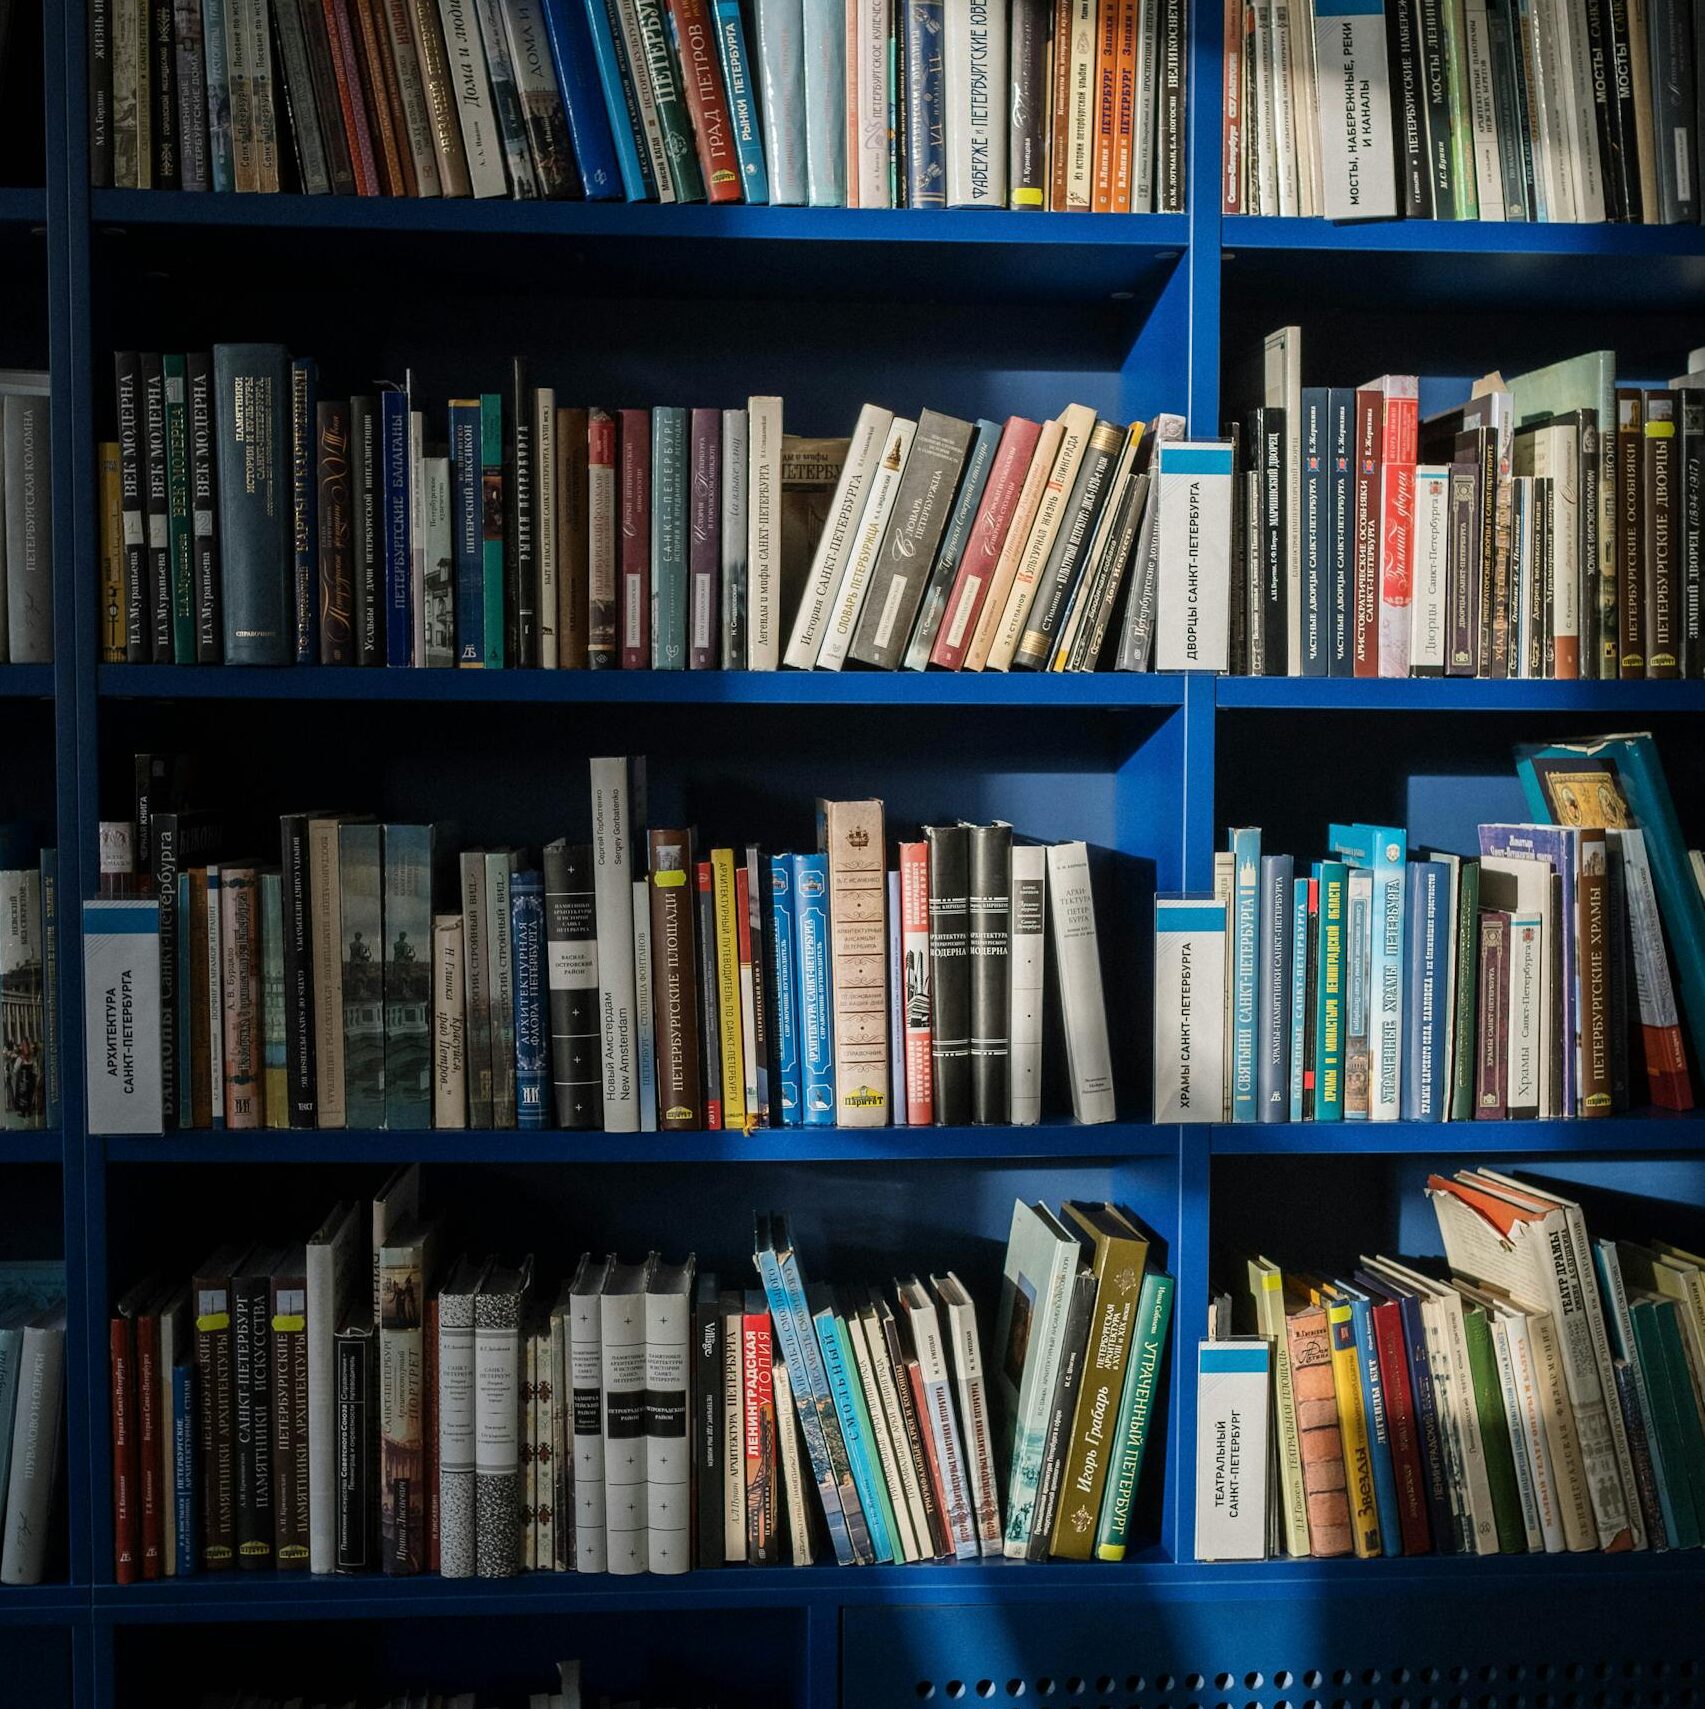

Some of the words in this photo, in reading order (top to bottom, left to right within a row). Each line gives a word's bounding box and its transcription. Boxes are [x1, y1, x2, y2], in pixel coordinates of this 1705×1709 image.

[517, 7, 528, 20] И
[1342, 22, 1353, 56] РЕКИ
[461, 48, 469, 57] и
[523, 25, 544, 77] ДОМА
[688, 24, 716, 101] ПЕТРОВ
[724, 22, 745, 94] ПЕТЕРБУРГА
[970, 30, 988, 126] ПЕТЕРБУРГСКИЕ
[1429, 54, 1443, 104] МОСТЫ
[1592, 47, 1607, 103] МОСТЫ
[1616, 43, 1631, 98] МОСТЫ
[181, 80, 192, 155] ЗНАМЕНИТЫЕ
[463, 64, 481, 108] Дома
[1343, 60, 1358, 153] НАБЕРЕЖНЫЕ,
[1360, 80, 1372, 134] КАНАЛЫ
[704, 108, 726, 157] ГРАД
[733, 99, 752, 141] РЫНКИ
[1362, 138, 1372, 147] И
[971, 137, 988, 198] ФАБЕРЖЕ
[1348, 156, 1360, 205] МОСТЫ,
[120, 373, 135, 456] МОДЕРНА
[147, 375, 163, 458] МОДЕРНА
[193, 373, 208, 457] МОДЕРНА
[234, 377, 244, 441] ПАМЯТНИКИ
[244, 377, 254, 432] КУЛЬТУРЫ
[23, 410, 35, 471] КОЛОМНА
[246, 434, 254, 444] И
[246, 445, 255, 493] ИСТОРИИ
[391, 414, 404, 488] БАЛАГАНЫ
[463, 424, 474, 486] ЛЕКСИКОН
[1045, 435, 1079, 493] ЛЕНИНГРАДА
[1267, 432, 1280, 468] ДВОРЕЦ
[123, 461, 138, 496] ВЕК
[151, 463, 165, 499] ВЕК
[196, 461, 210, 497] ВЕК
[663, 418, 674, 562] САНКТ-ПЕТЕРБУРГ
[915, 470, 943, 540] ПЕТЕРБУРЖЦА
[1266, 469, 1280, 527] МАРИИНСКИЙ
[1586, 469, 1596, 543] МИХАЙЛОВСКИЙ
[1626, 443, 1638, 523] ОСОБНЯКИ
[1656, 439, 1670, 508] ДВОРЦЫ
[24, 473, 36, 572] ПЕТЕРБУРГСКАЯ
[464, 488, 476, 553] ПИТЕРСКИЙ
[758, 464, 770, 560] САНКТ-ПЕТЕРБУРГА
[1039, 495, 1059, 526] ЖИЗНЬ
[1187, 482, 1200, 603] САНКТ-ПЕТЕРБУРГА
[1308, 478, 1318, 568] САНКТ-ПЕТЕРБУРГА
[1336, 478, 1346, 568] САНКТ-ПЕТЕРБУРГА
[1359, 480, 1368, 541] ОСОБНЯКИ
[392, 496, 406, 609] ПЕТЕРБУРГСКИЕ
[758, 563, 771, 594] мифы
[800, 599, 823, 646] История
[815, 474, 863, 596] САНКТ-ПЕТЕРБУРГА
[836, 592, 859, 635] СЛОВАРЬ
[850, 522, 881, 590] ПЕТЕРБУРЖЦА
[1017, 529, 1050, 584] КУЛЬТУРНАЯ
[1105, 581, 1118, 604] Дом
[1112, 528, 1133, 578] Искусств
[1366, 519, 1376, 622] САНКТ-ПЕТЕРБУРГА
[1426, 498, 1441, 595] Санкт-Петербурга
[1459, 522, 1468, 593] САНКТ-ПЕТЕРБУРГА
[1587, 544, 1596, 575] ЗАМОК
[1656, 513, 1670, 644] ПЕТЕРБУРГСКИЕ
[1688, 530, 1699, 581] ДВОРЕЦ
[1308, 569, 1318, 611] ДВОРЦЫ
[1336, 569, 1347, 611] ДВОРЦЫ
[1357, 542, 1368, 661] АРИСТОКРАТИЧЕСКИЕ
[1458, 594, 1467, 628] ДВОРЦЫ
[1626, 526, 1639, 642] ПЕТЕРБУРГСКИЕ
[1688, 584, 1700, 640] ЗИМНИЙ
[757, 605, 769, 646] Легенды
[1186, 606, 1198, 660] ДВОРЦЫ
[1308, 613, 1318, 659] ЧАСТНЫЕ
[1336, 613, 1346, 659] ЧАСТНЫЕ
[1424, 603, 1439, 656] Дворцы
[594, 789, 605, 835] Горбатенко
[611, 789, 622, 835] Gorbatenko
[596, 837, 607, 866] Сергей
[613, 837, 625, 866] Sergey
[665, 892, 680, 967] ПЛОЩАДИ
[1273, 876, 1283, 967] САНКТ-ПЕТЕРБУРГА
[1328, 881, 1341, 920] ОБЛАСТИ
[1385, 879, 1400, 956] ПЕТЕРБУРГА
[1590, 886, 1603, 944] ХРАМЫ
[517, 921, 530, 1044] АРХИТЕКТУРНАЯ
[527, 920, 538, 997] ПЕТЕРБУРГА
[805, 919, 817, 1002] САНКТ-ПЕТЕРБУРГА
[817, 941, 827, 1040] СПРАВОЧНИК-ПУТЕВОДИТЕЛЬ
[1238, 898, 1255, 1023] САНКТ-ПЕТЕРБУРГА
[1325, 925, 1340, 993] ЛЕНИНГРАДСКОЙ
[1384, 965, 1398, 1012] ХРАМЫ
[1521, 944, 1535, 1038] Санкт-Петербурга
[105, 988, 119, 1077] АРХИТЕКТУРА
[121, 969, 135, 1094] САНКТ-ПЕТЕРБУРГА
[529, 1002, 540, 1046] ФЛОРА
[603, 992, 615, 1059] Амстердам
[667, 973, 684, 1091] ПЕТЕРБУРГСКИЕ
[808, 1002, 819, 1063] АРХИТЕКТУРА
[1180, 942, 1192, 1061] САНКТ-ПЕТЕРБУРГА
[1272, 968, 1283, 1065] ХРАМЫ-ПАМЯТНИКИ
[1324, 999, 1338, 1052] МОНАСТЫРИ
[1590, 950, 1605, 1081] ПЕТЕРБУРГСКИЕ
[617, 1007, 629, 1073] Amsterdam
[1237, 1028, 1252, 1092] СВЯТЫНИ
[1381, 1020, 1397, 1104] УТРАЧЕННЫЕ
[1517, 1046, 1532, 1097] Храмы
[604, 1061, 616, 1101] Новый
[619, 1075, 630, 1101] New
[1180, 1064, 1191, 1109] ХРАМЫ
[1324, 1069, 1337, 1102] ХРАМЫ
[1548, 1232, 1567, 1277] ДРАМЫ
[767, 1267, 793, 1333] СМОЛЬНОГО
[1557, 1277, 1575, 1316] ТЕАТР
[254, 1294, 268, 1391] ИСКУССТВА
[758, 1331, 771, 1406] УТОПИЯ
[782, 1334, 809, 1395] АНСАМБЛЬ
[1096, 1303, 1115, 1369] ПЕТЕРБУРГСКАЯ
[1104, 1312, 1122, 1370] АРХИТЕКТУРА
[199, 1334, 212, 1451] ПЕТЕРБУРГСКИЕ
[216, 1334, 230, 1437] АРХИТЕКТУРЫ
[236, 1294, 251, 1444] САНКТ-ПЕТЕРБУРГ
[277, 1334, 290, 1451] ПЕТЕРБУРГСКИЕ
[295, 1334, 308, 1437] АРХИТЕКТУРЫ
[407, 1347, 420, 1420] ПОРТРЕТ
[726, 1331, 737, 1407] ПЕТЕРБУРГА
[745, 1330, 759, 1456] ЛЕНИНГРАДСКАЯ
[823, 1332, 860, 1442] СМОЛЬНЫЙ
[895, 1364, 912, 1408] КОЛОННЫ
[1126, 1341, 1158, 1442] УТРАЧЕННЫЙ
[1278, 1350, 1292, 1401] ПЛОЩАДЬ
[1368, 1358, 1378, 1382] БДТ
[729, 1413, 739, 1478] АРХИТЕКТУРА
[908, 1418, 920, 1442] АРКИ
[1083, 1385, 1110, 1446] Грабарь
[1283, 1404, 1298, 1470] ТЕАТРАЛЬНАЯ
[1371, 1385, 1387, 1444] ЛЕГЕНДЫ
[218, 1443, 231, 1533] ПАМЯТНИКИ
[255, 1405, 269, 1508] ПАМЯТНИКИ
[296, 1443, 309, 1533] ПАМЯТНИКИ
[912, 1443, 934, 1514] ТРИУМФАЛЬНЫЕ
[1075, 1449, 1099, 1493] Игорь
[1215, 1421, 1227, 1508] ТЕАТРАЛЬНЫЙ
[1229, 1408, 1242, 1518] САНКТ-ПЕТЕРБУРГ
[1109, 1447, 1143, 1535] ПЕТЕРБУРГ
